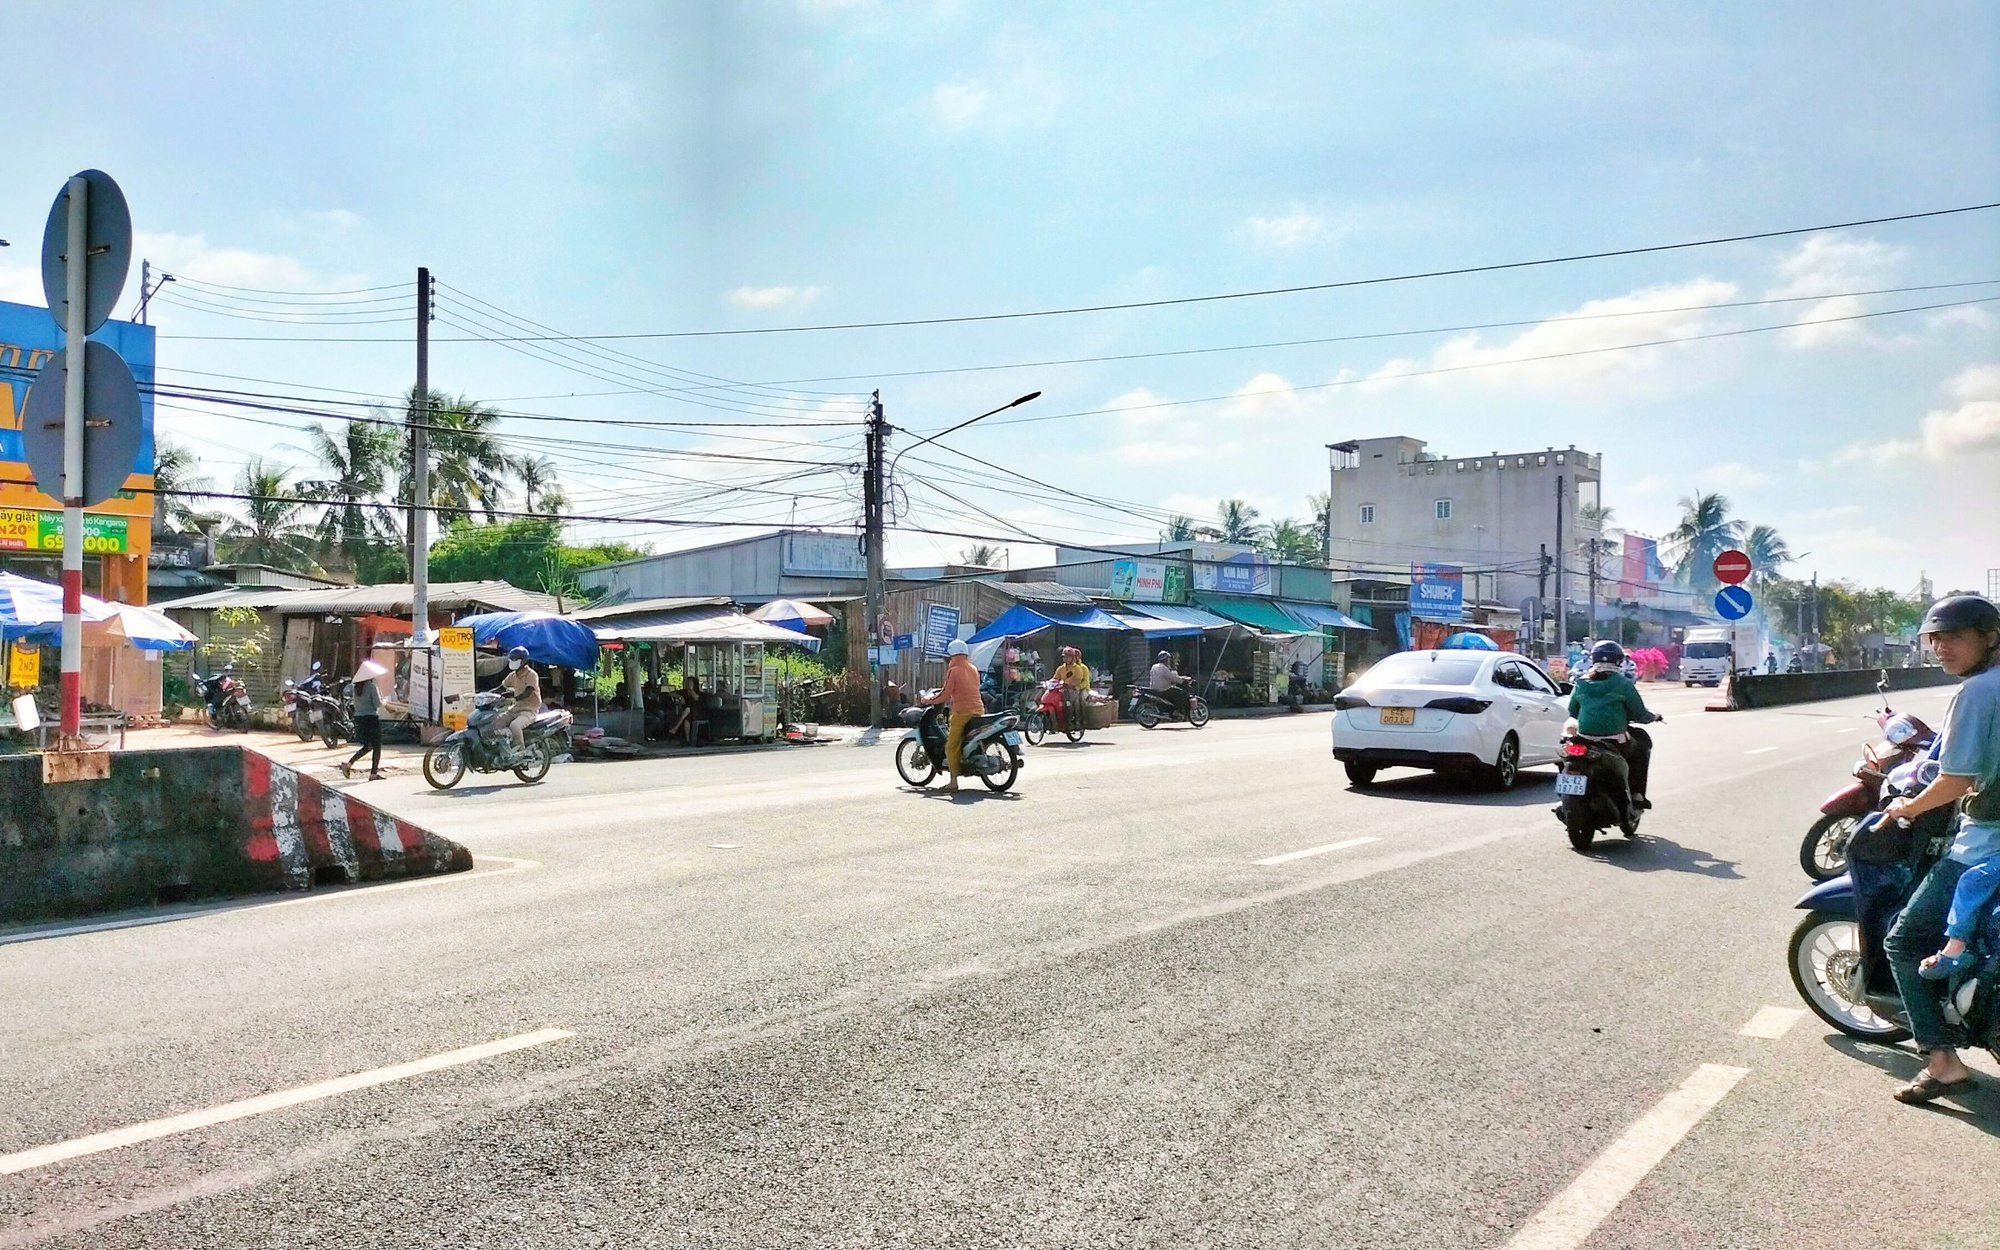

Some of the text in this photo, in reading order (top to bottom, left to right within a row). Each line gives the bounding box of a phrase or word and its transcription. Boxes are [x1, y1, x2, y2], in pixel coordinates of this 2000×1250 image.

[15, 511, 36, 523] giặt
[94, 518, 127, 528] Kangaroo
[1136, 577, 1152, 589] MINH
[1420, 583, 1456, 600] SHUNFA
